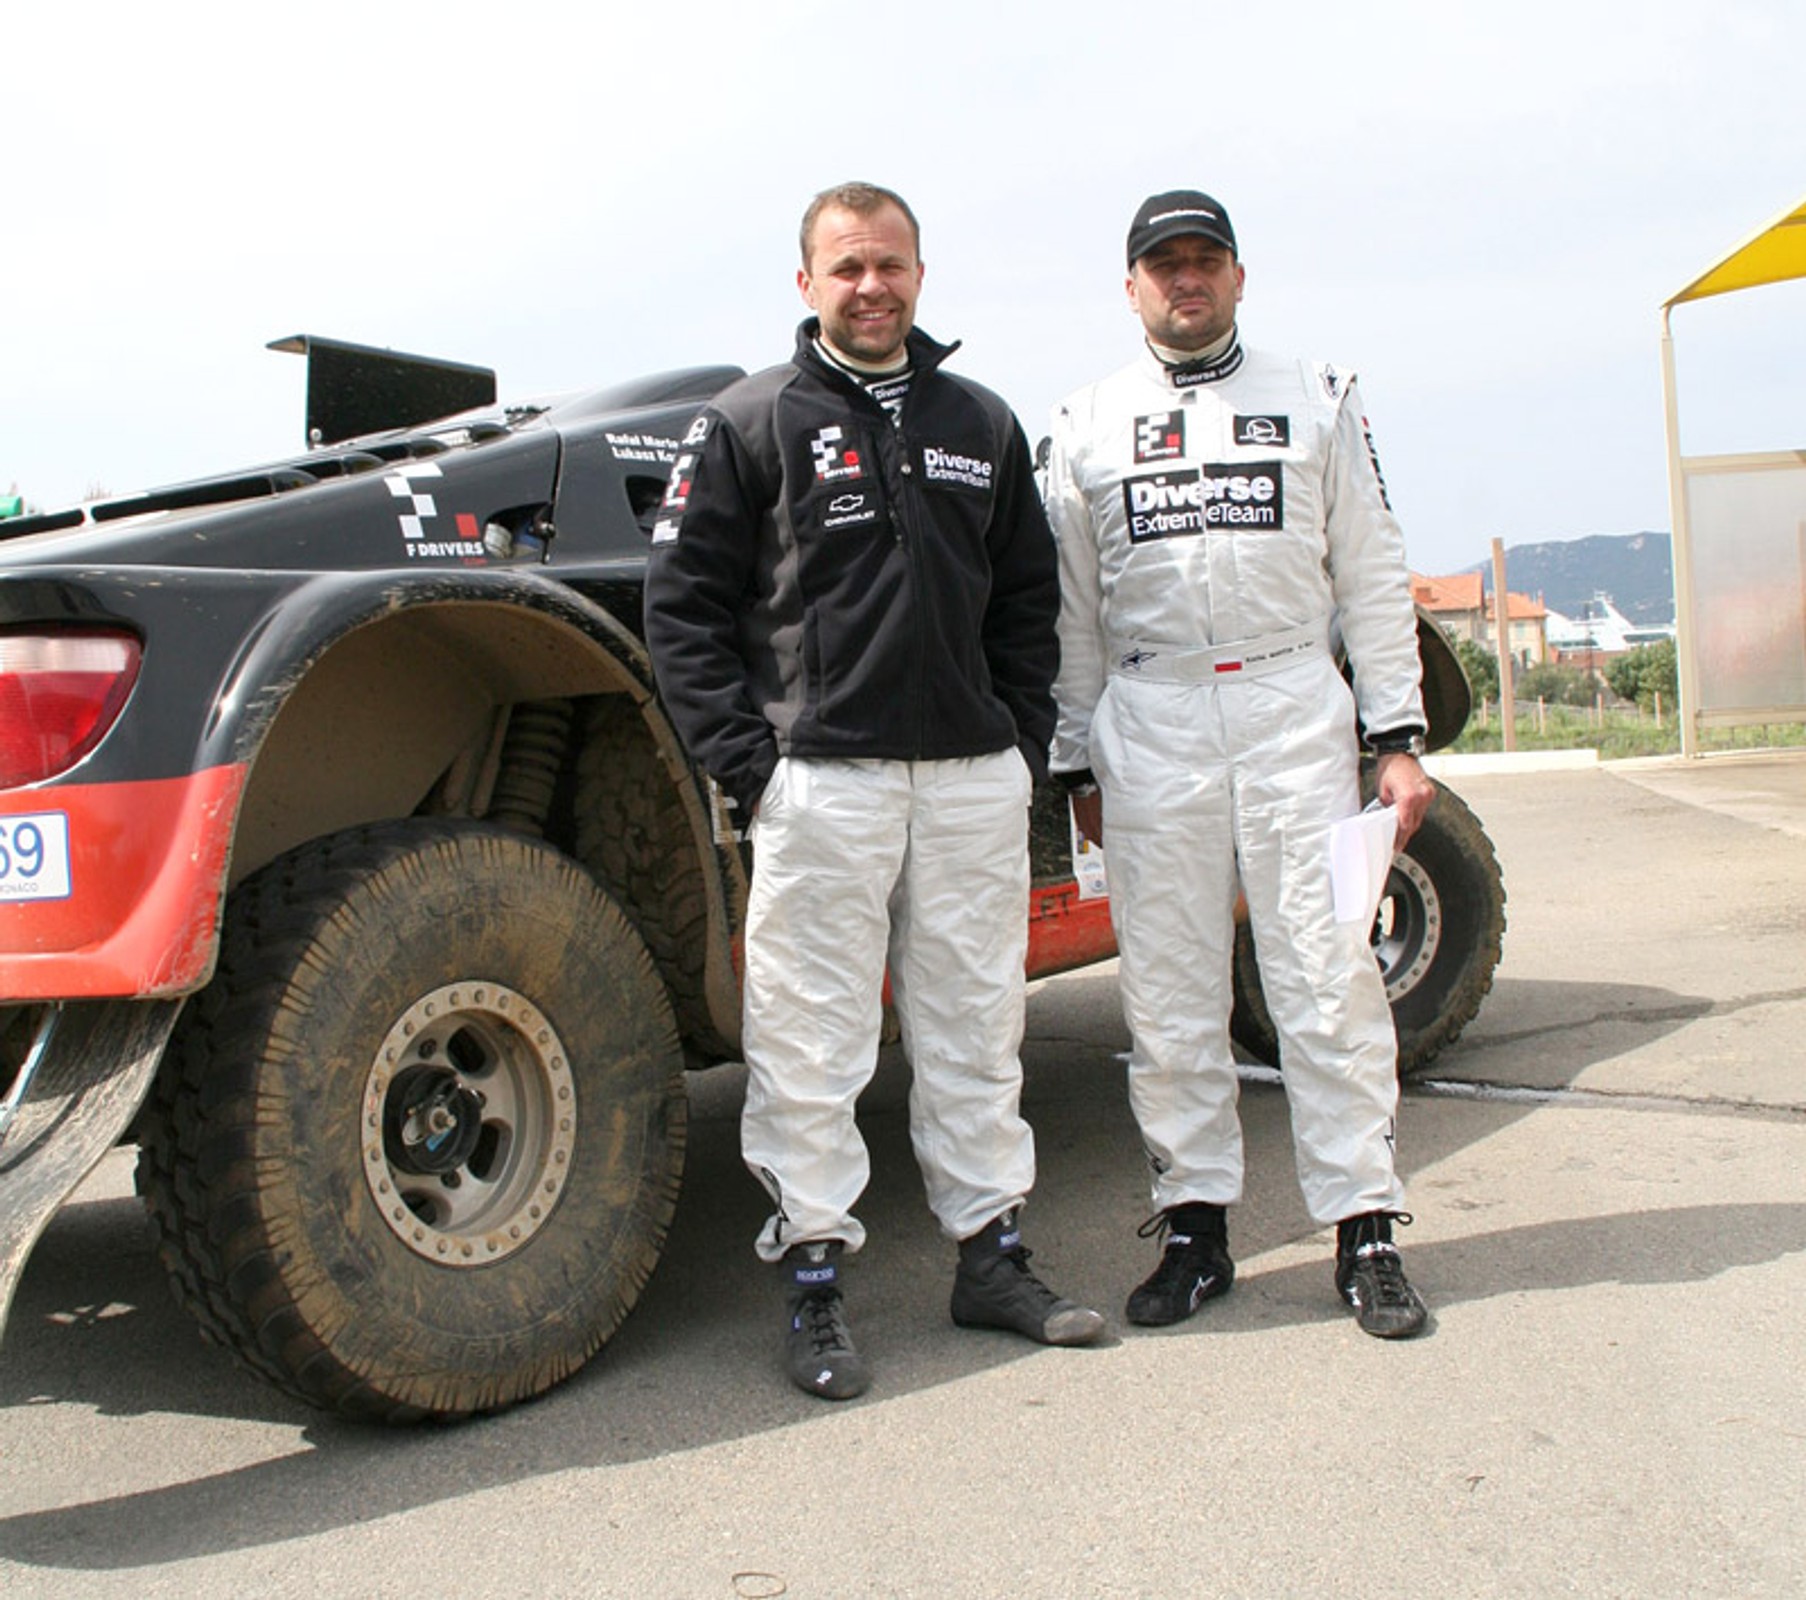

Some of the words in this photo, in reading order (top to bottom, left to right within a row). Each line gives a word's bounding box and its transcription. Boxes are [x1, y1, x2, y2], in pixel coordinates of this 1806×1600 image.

[923, 446, 993, 477] Diverse
[1131, 475, 1275, 513] Diverse
[418, 541, 485, 557] DRIVERS
